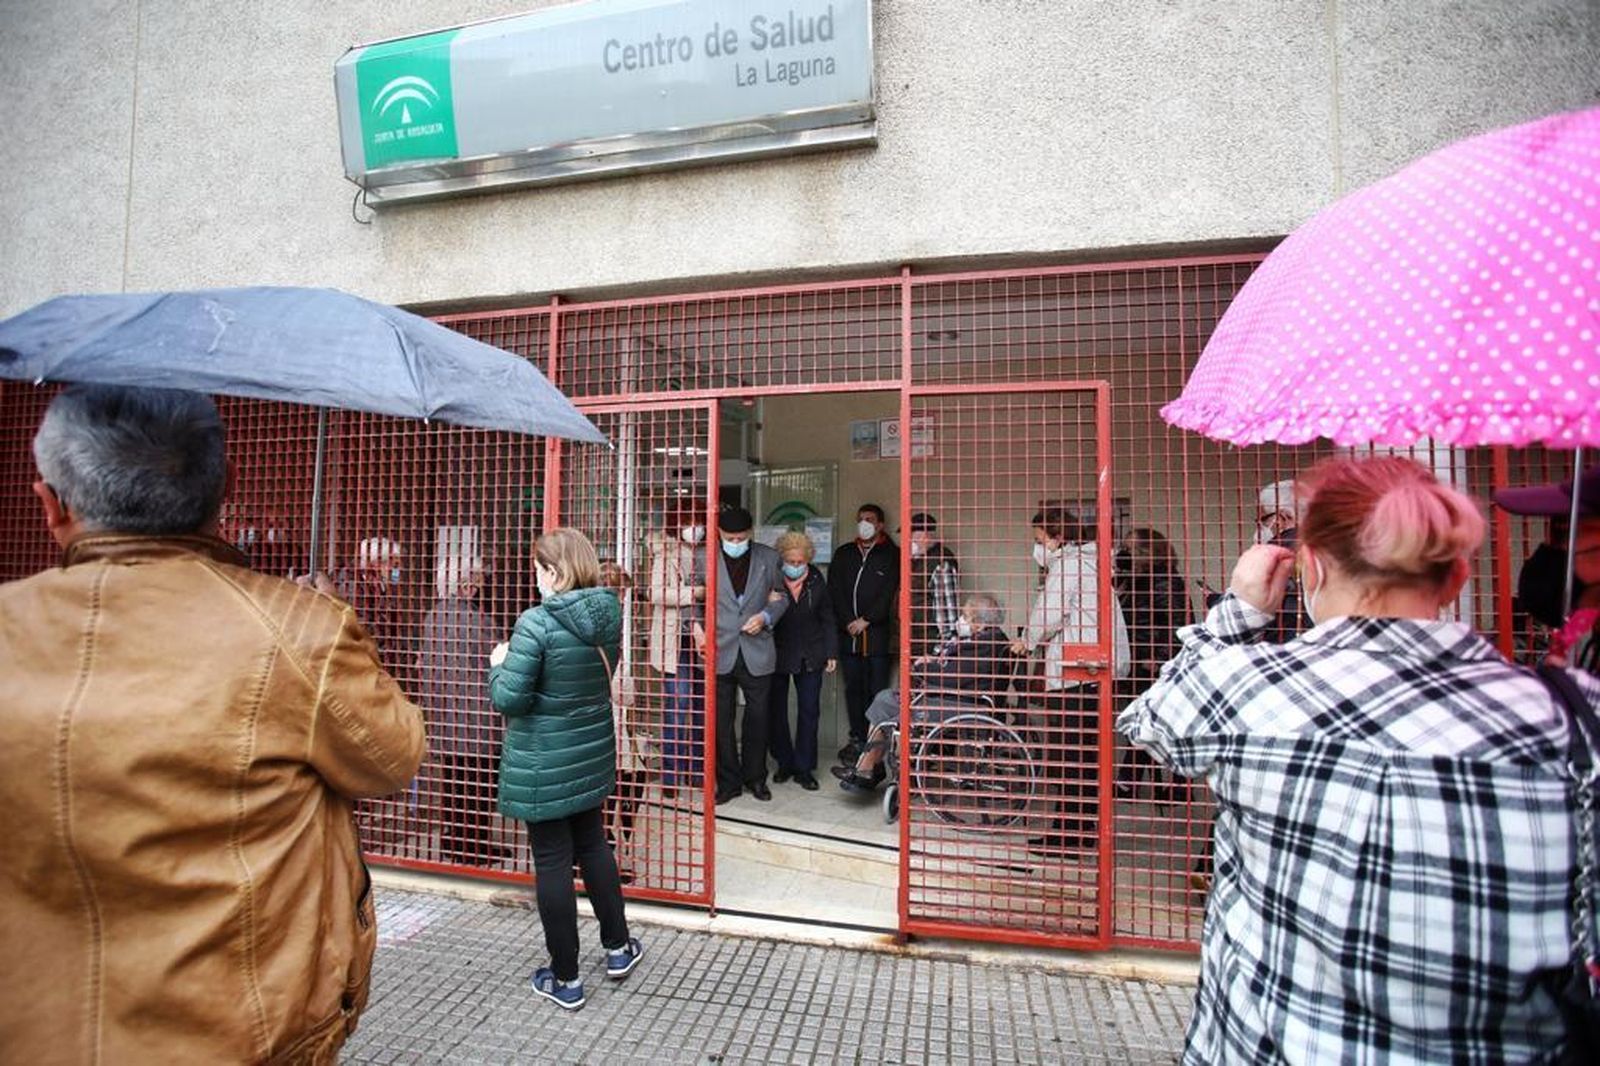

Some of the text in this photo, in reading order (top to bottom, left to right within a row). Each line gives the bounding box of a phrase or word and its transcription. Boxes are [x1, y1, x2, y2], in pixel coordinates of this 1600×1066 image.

[603, 4, 834, 73] Centro de Salud
[736, 55, 836, 88] La Laguna
